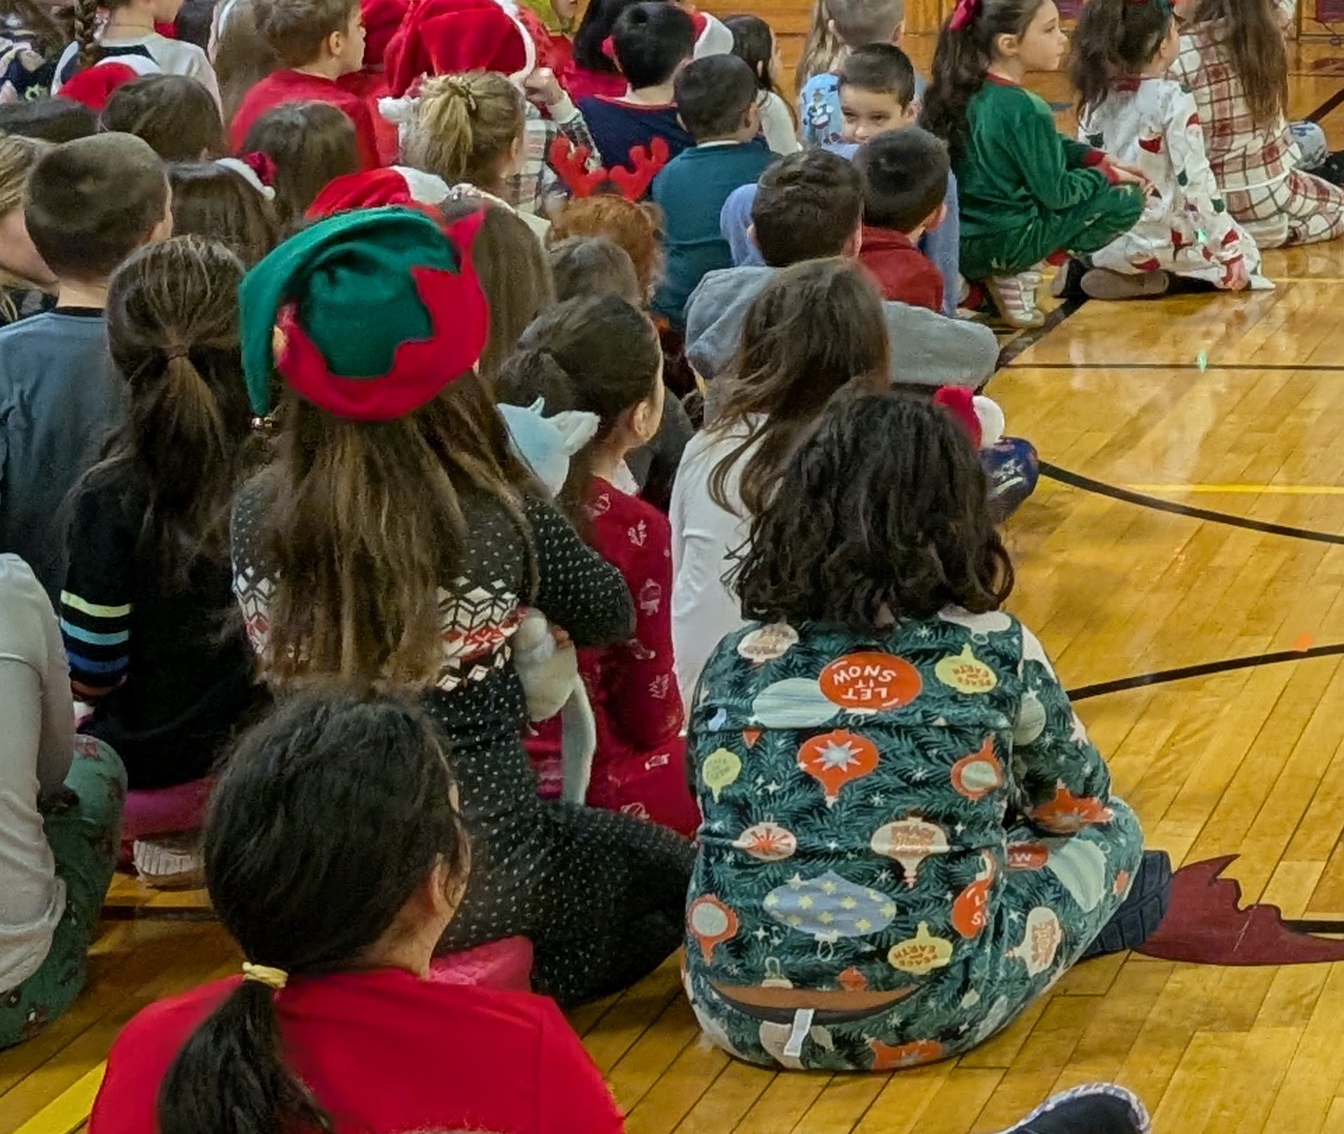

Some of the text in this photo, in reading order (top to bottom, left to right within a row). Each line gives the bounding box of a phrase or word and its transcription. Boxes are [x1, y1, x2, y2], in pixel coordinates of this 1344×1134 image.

[833, 665, 897, 685] SNOW
[855, 679, 875, 688] IT
[841, 687, 888, 701] LET
